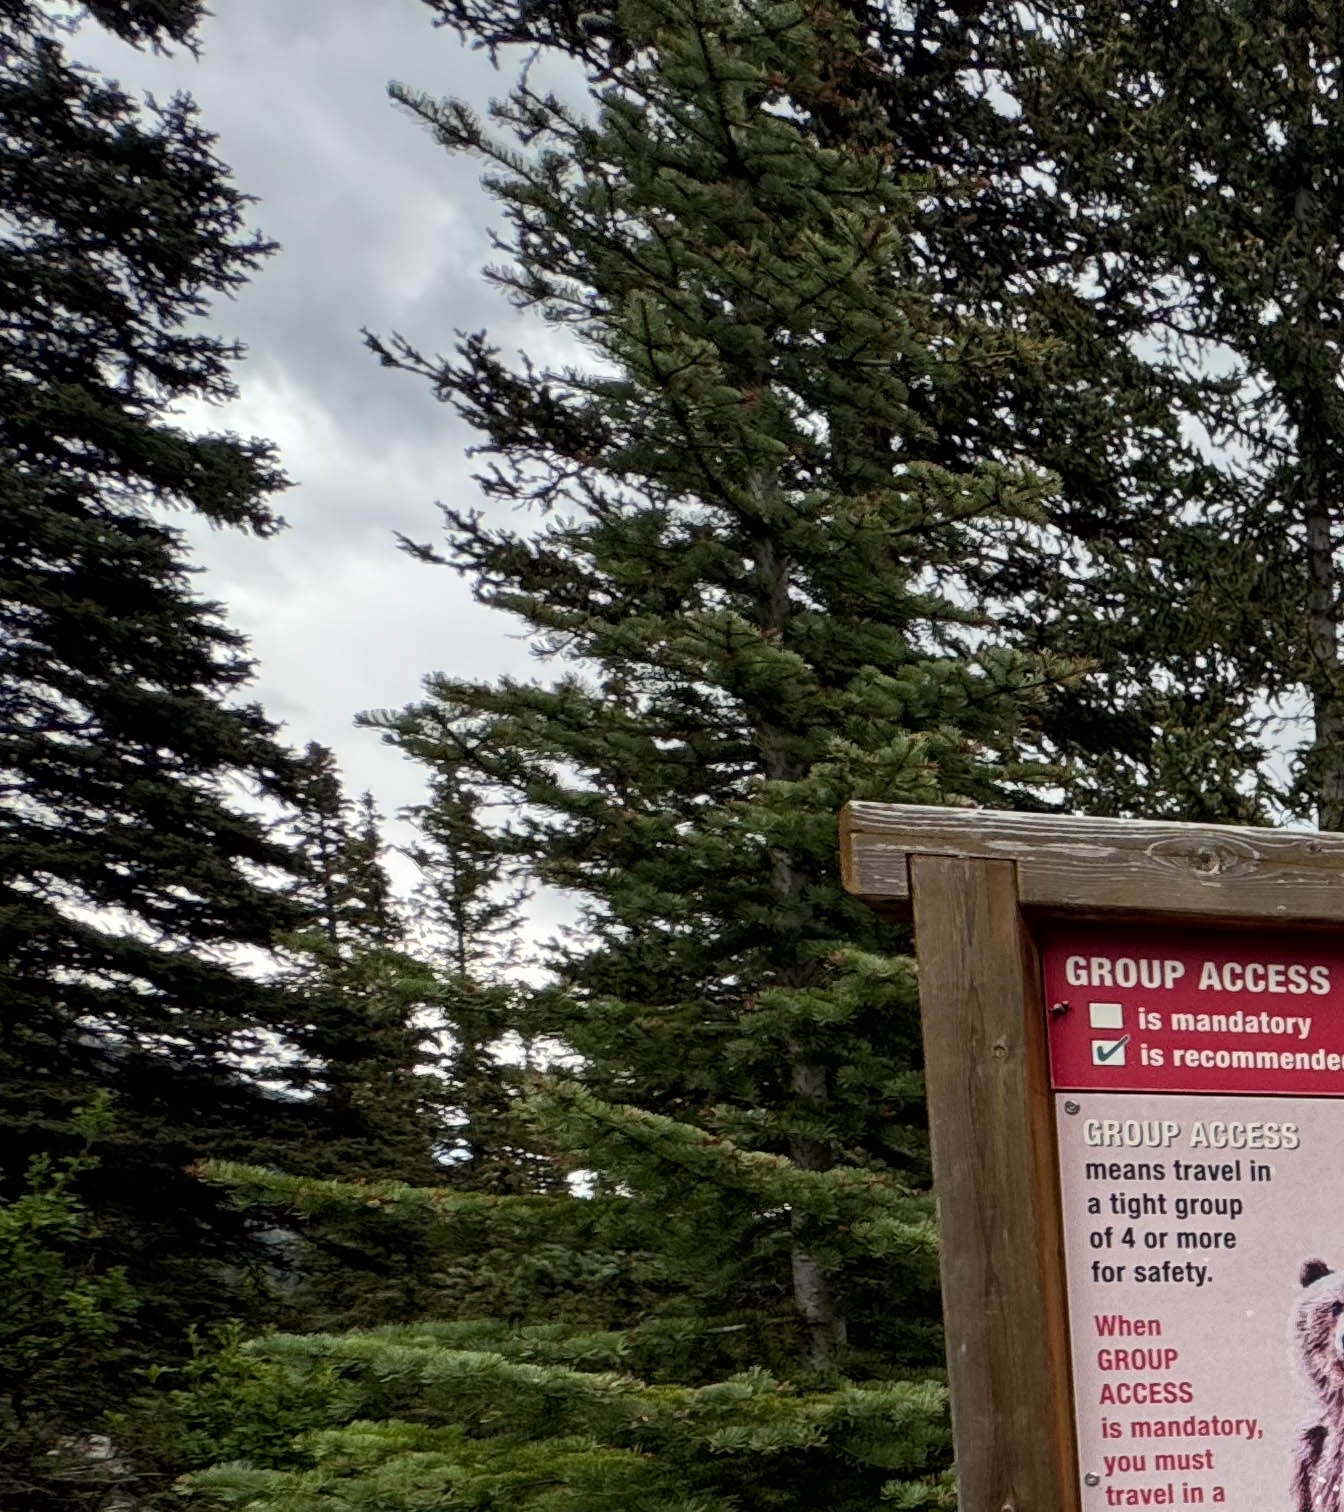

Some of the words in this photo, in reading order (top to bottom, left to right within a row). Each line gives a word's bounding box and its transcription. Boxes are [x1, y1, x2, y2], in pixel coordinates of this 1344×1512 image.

[1065, 955, 1185, 988] GROUP
[1199, 962, 1330, 994] ACCESS
[1138, 1009, 1162, 1031] is
[1171, 1012, 1311, 1039] mandatory
[1141, 1045, 1162, 1066] is
[1083, 1119, 1180, 1147] GROUP
[1191, 1122, 1300, 1149] ACCESS
[1086, 1163, 1166, 1183] means
[1173, 1160, 1242, 1182] travel
[1250, 1160, 1271, 1182] in
[1088, 1197, 1102, 1214] a
[1110, 1193, 1167, 1220] tight
[1176, 1197, 1242, 1220] group
[1090, 1227, 1114, 1248] of
[1122, 1228, 1136, 1248] 4
[1144, 1230, 1169, 1248] or
[1177, 1230, 1236, 1248] more
[1091, 1261, 1125, 1282] for
[1134, 1261, 1213, 1287] safety.
[1095, 1315, 1161, 1336] When
[1097, 1349, 1178, 1371] GROUP
[1099, 1382, 1193, 1404] ACCESS
[1101, 1417, 1122, 1438] is
[1131, 1416, 1263, 1440] mandatory,
[1104, 1455, 1146, 1476] you
[1156, 1450, 1214, 1471] must
[1105, 1483, 1173, 1506] travel
[1182, 1482, 1203, 1504] in
[1213, 1485, 1225, 1503] a
